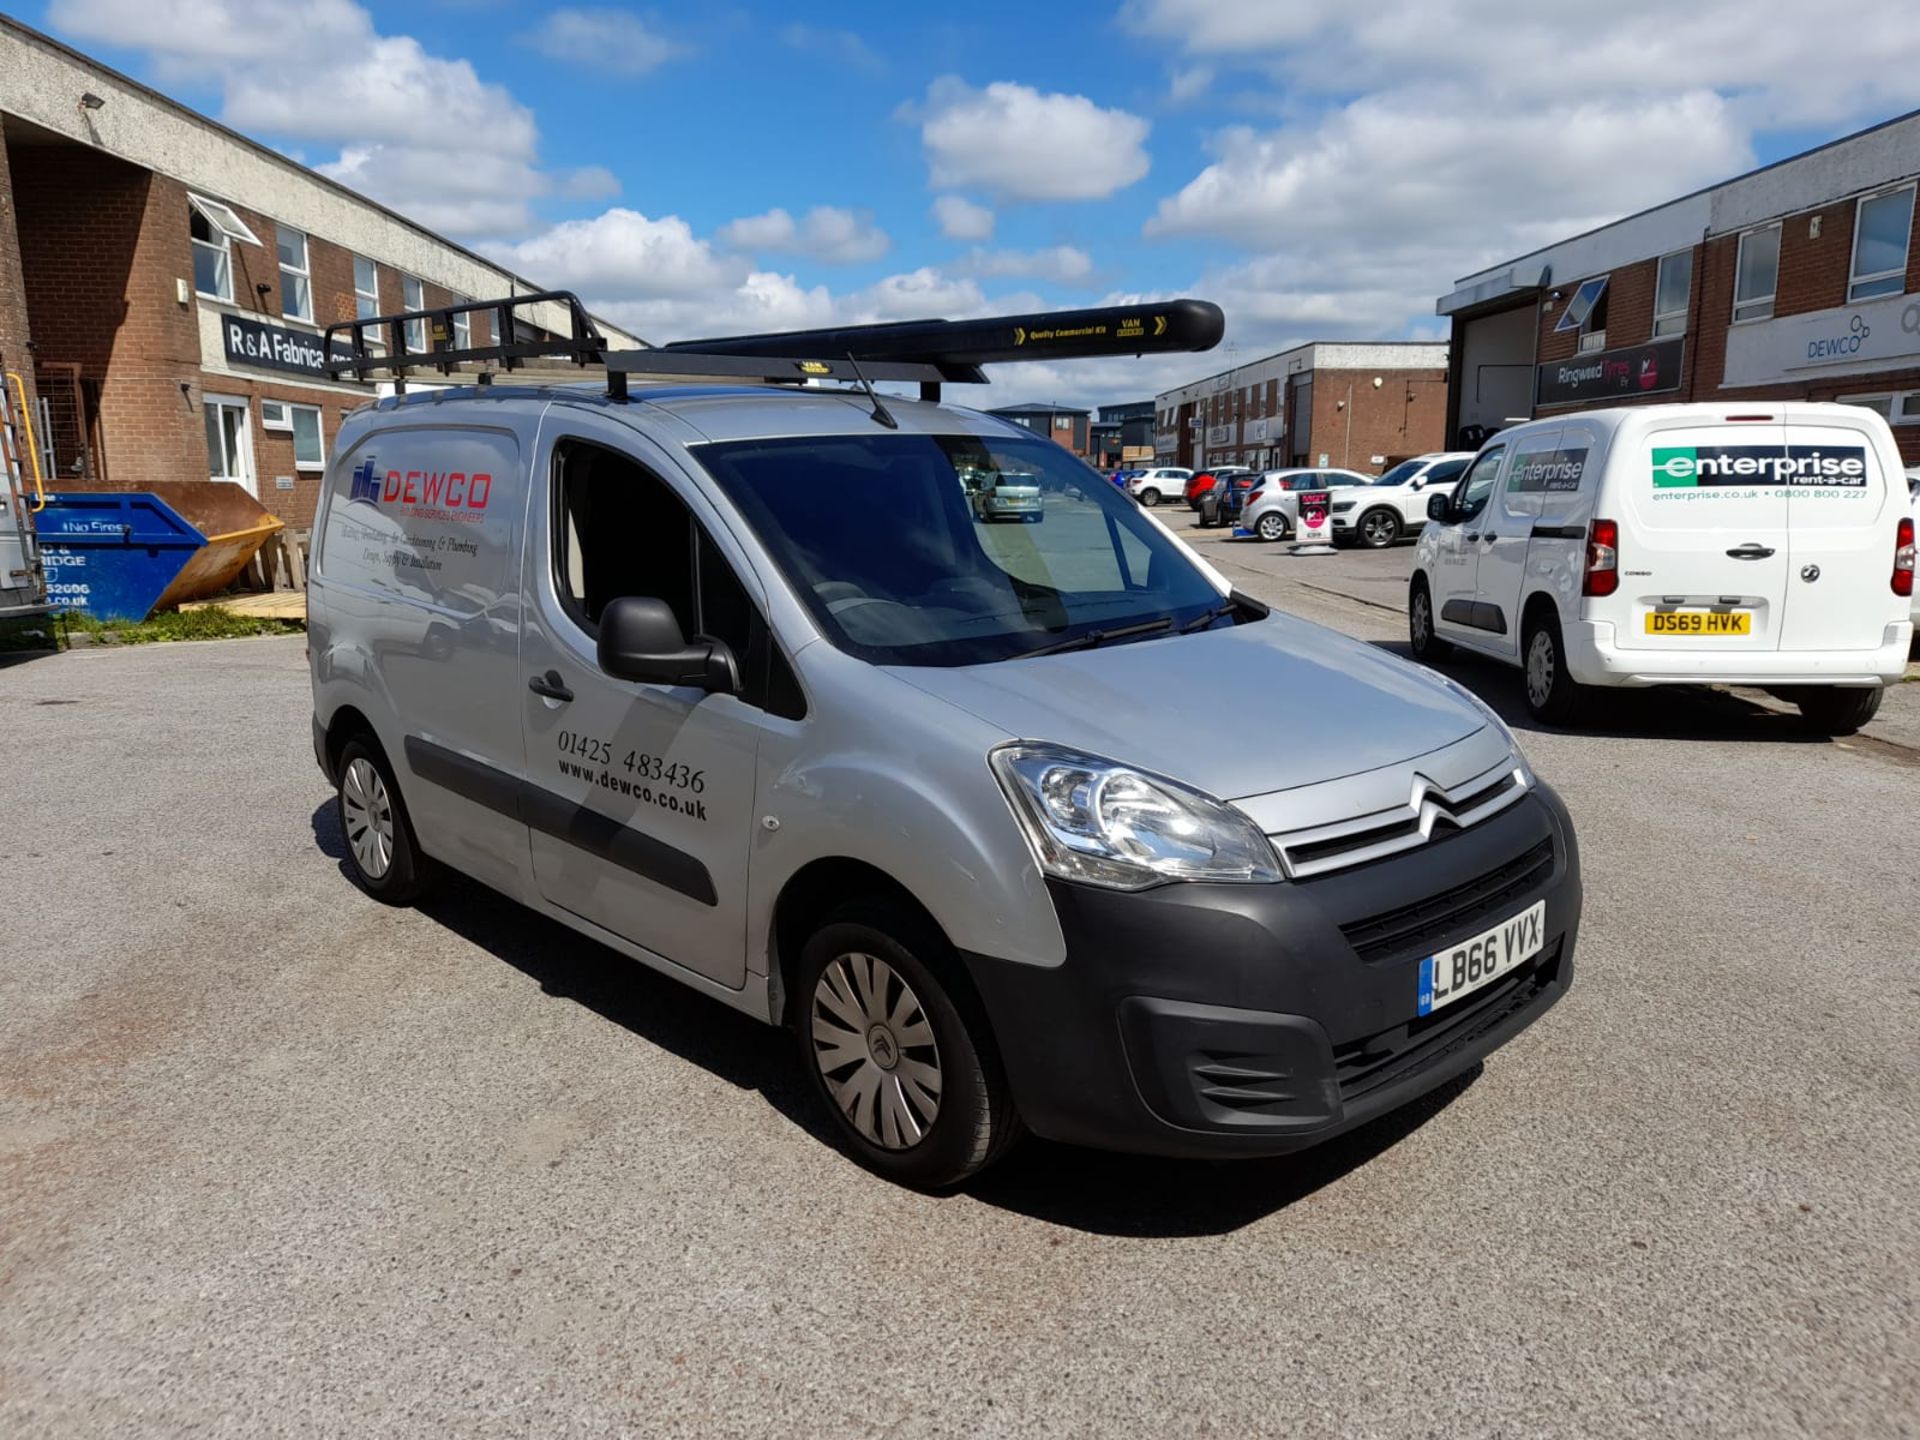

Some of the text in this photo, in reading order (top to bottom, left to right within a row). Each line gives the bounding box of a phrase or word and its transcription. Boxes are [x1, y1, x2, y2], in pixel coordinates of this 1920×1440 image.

[1121, 318, 1141, 328] VAN
[230, 324, 352, 372] R & A Fabrica
[1807, 335, 1861, 358] DEWCO
[1558, 361, 1603, 388] Ringwood
[1512, 457, 1583, 487] enterprise
[1656, 452, 1864, 480] enterprise
[383, 470, 493, 509] DEWCO
[1793, 475, 1863, 485] rent-a-car
[1652, 489, 1867, 501] enterprise.co.uk 0800 800 227
[69, 521, 89, 533] No
[1653, 615, 1743, 631] DS69 HVK
[558, 731, 706, 794] 01425 483436
[558, 759, 708, 822] www.dewco.co.uk
[1432, 934, 1498, 1001] LB66
[1504, 909, 1540, 964] VVX
